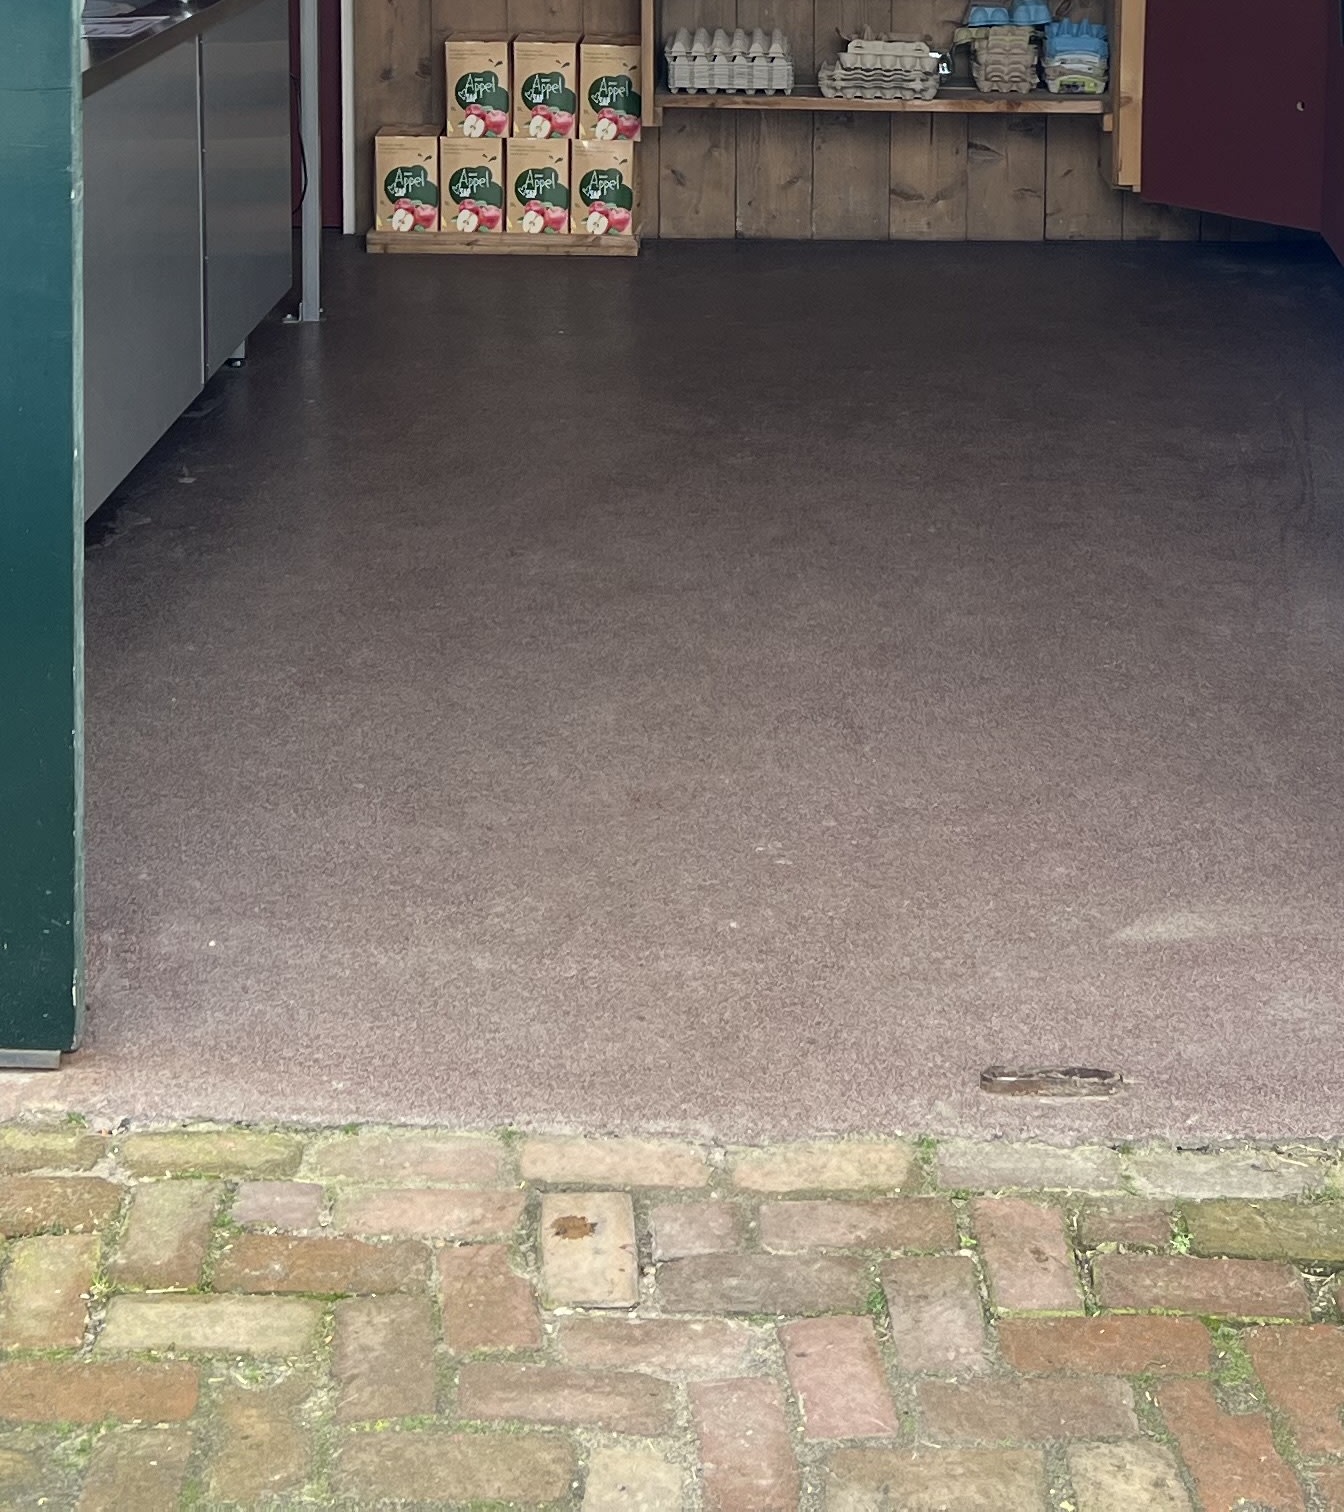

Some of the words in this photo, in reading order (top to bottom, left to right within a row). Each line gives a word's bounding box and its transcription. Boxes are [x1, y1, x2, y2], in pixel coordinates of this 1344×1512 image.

[466, 73, 496, 98] Appel
[532, 74, 563, 99] Appel
[600, 77, 630, 102] Appel
[394, 167, 425, 193] Appel
[459, 168, 490, 194] Appel
[524, 170, 556, 195] Appel
[589, 170, 621, 196] Appel
